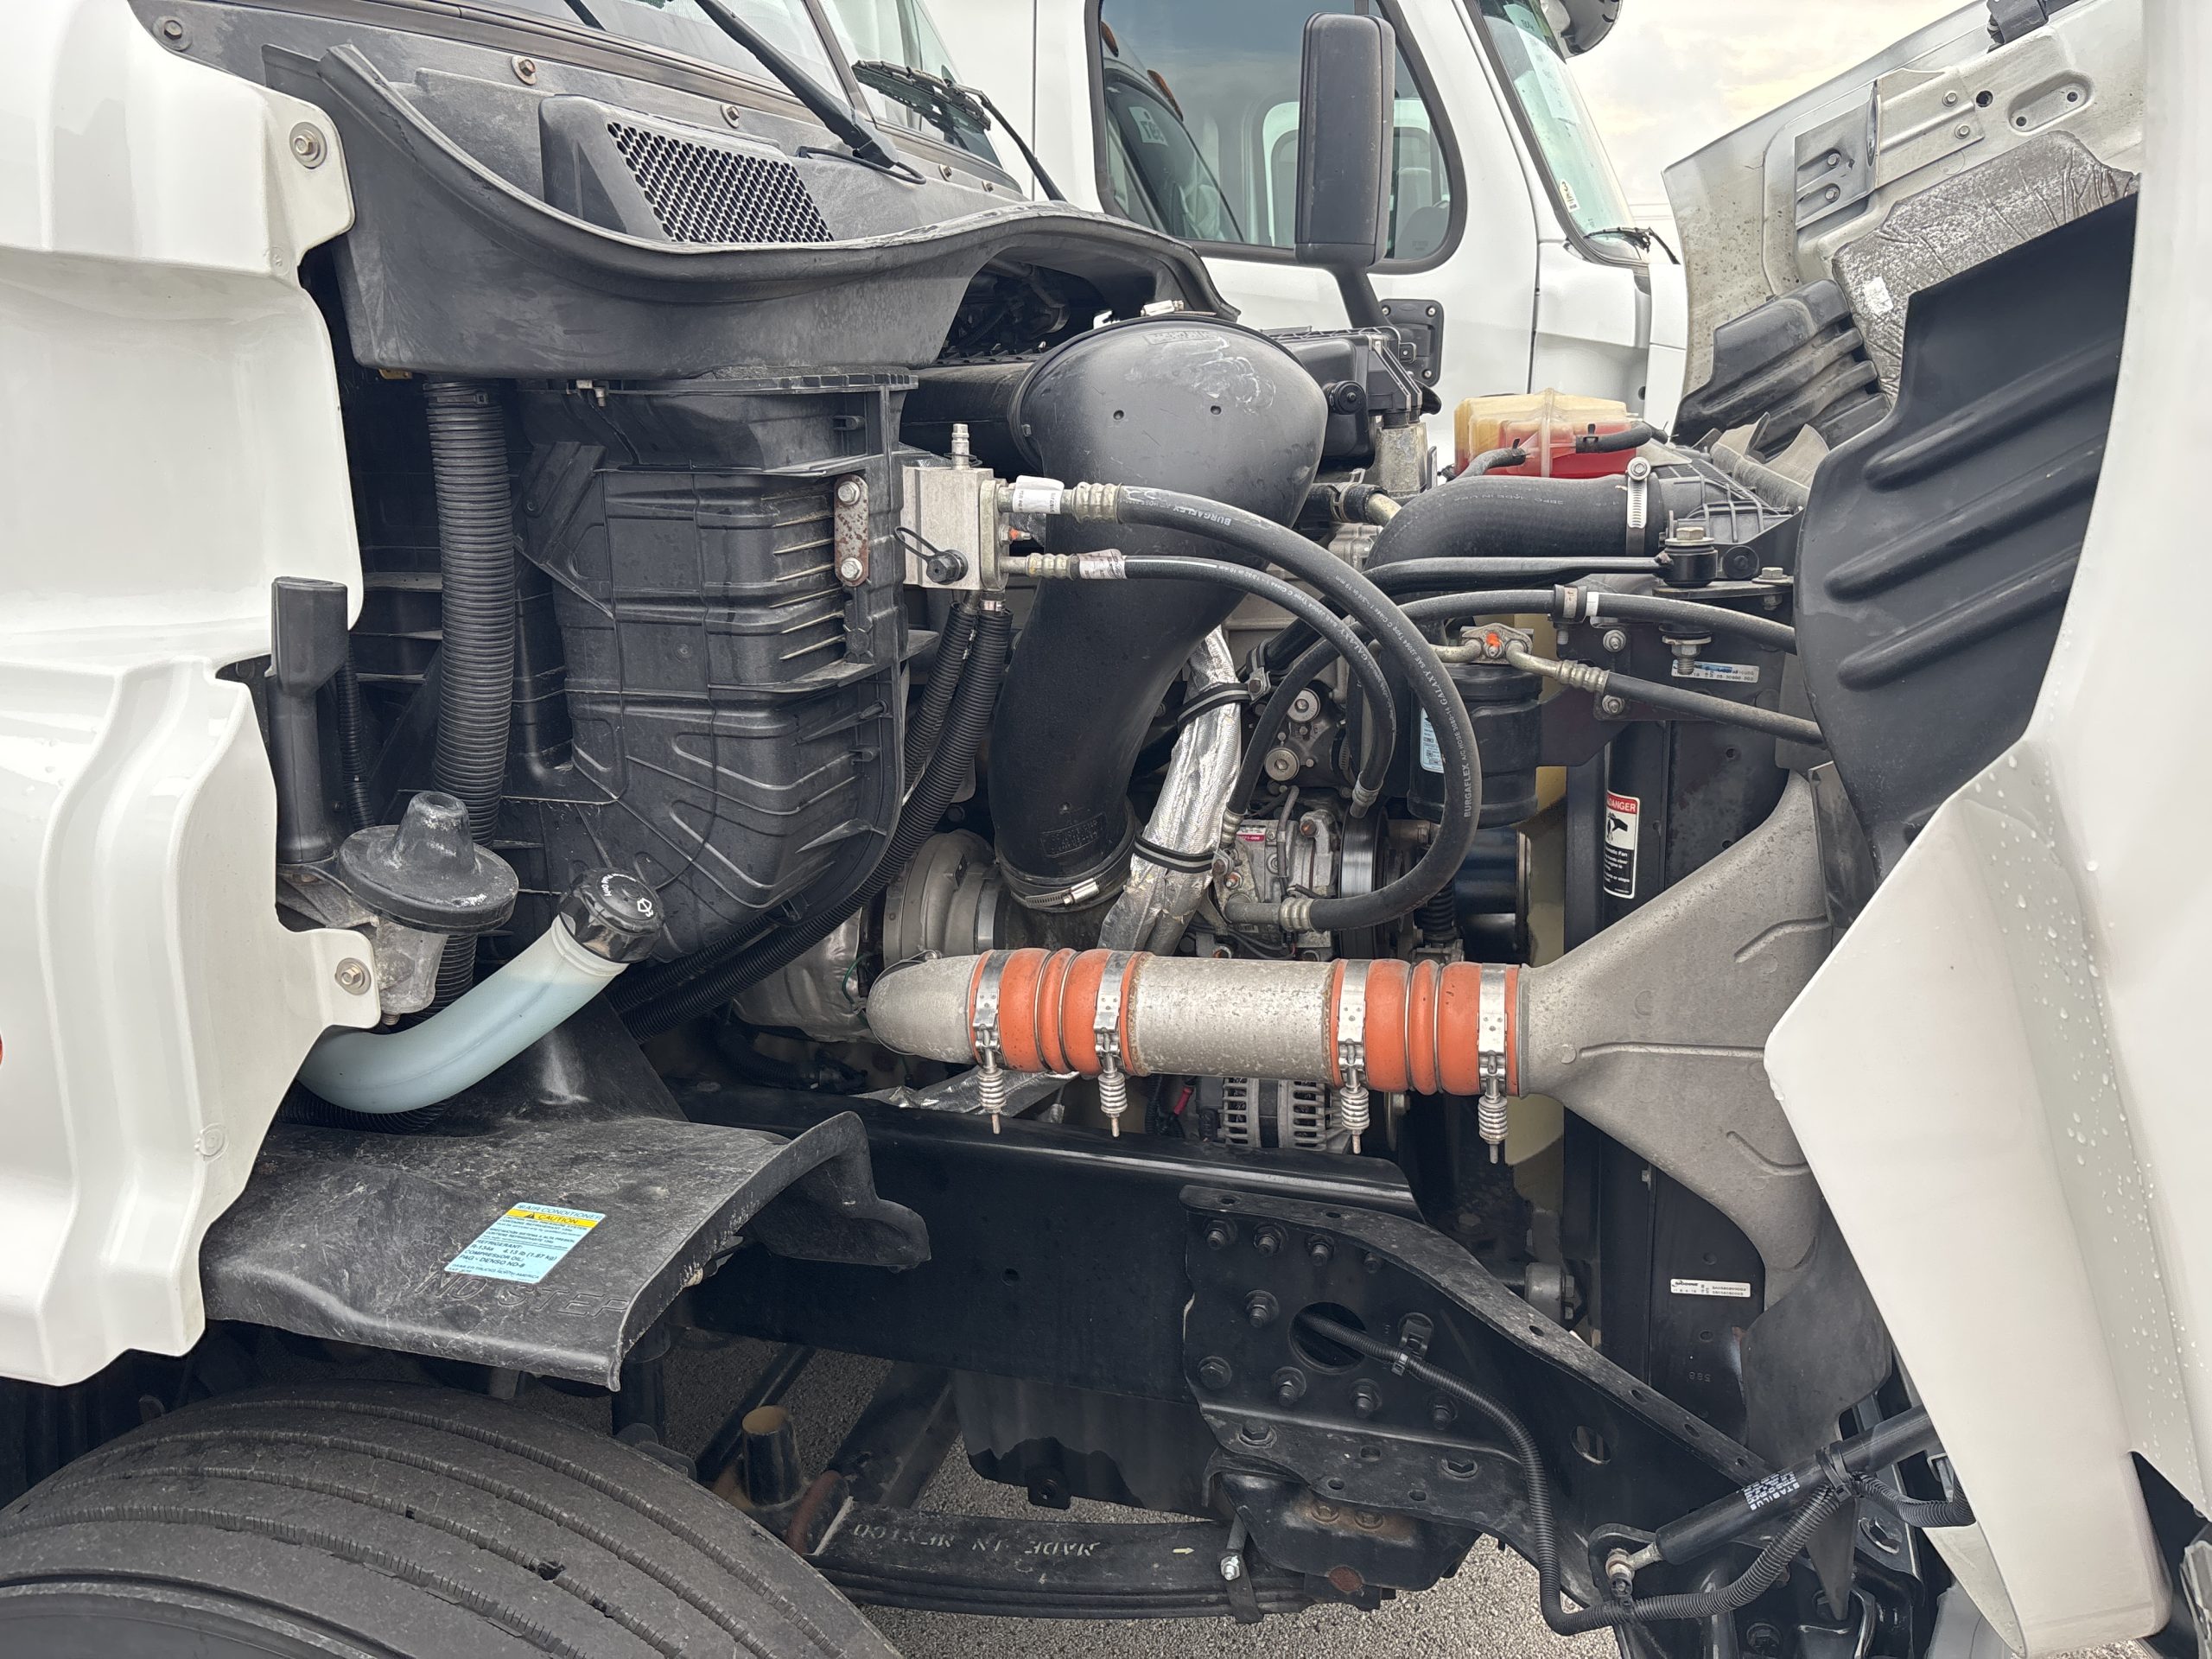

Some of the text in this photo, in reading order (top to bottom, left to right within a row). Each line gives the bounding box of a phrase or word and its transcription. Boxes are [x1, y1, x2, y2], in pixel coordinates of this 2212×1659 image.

[1173, 504, 1231, 525] BURGAFLEX
[1372, 607, 1389, 623] Class
[1390, 625, 1406, 641] Type
[1337, 625, 1369, 661] GALAXY
[1414, 655, 1426, 669] SAE
[1421, 667, 1448, 706] GALAXY
[1453, 731, 1464, 749] HOSE
[1461, 762, 1471, 817] BURGAFLEX
[1609, 800, 1636, 812] DANGER
[537, 1214, 580, 1224] CAUTION
[539, 1207, 603, 1220] CONDITIONER
[463, 1249, 512, 1259] COMPRESSOR
[478, 1256, 507, 1265] DENSO
[414, 1267, 630, 1319] NO STEP
[1750, 1481, 1800, 1511] STABILUS
[853, 1523, 1101, 1557] MADE IN MEXICO
